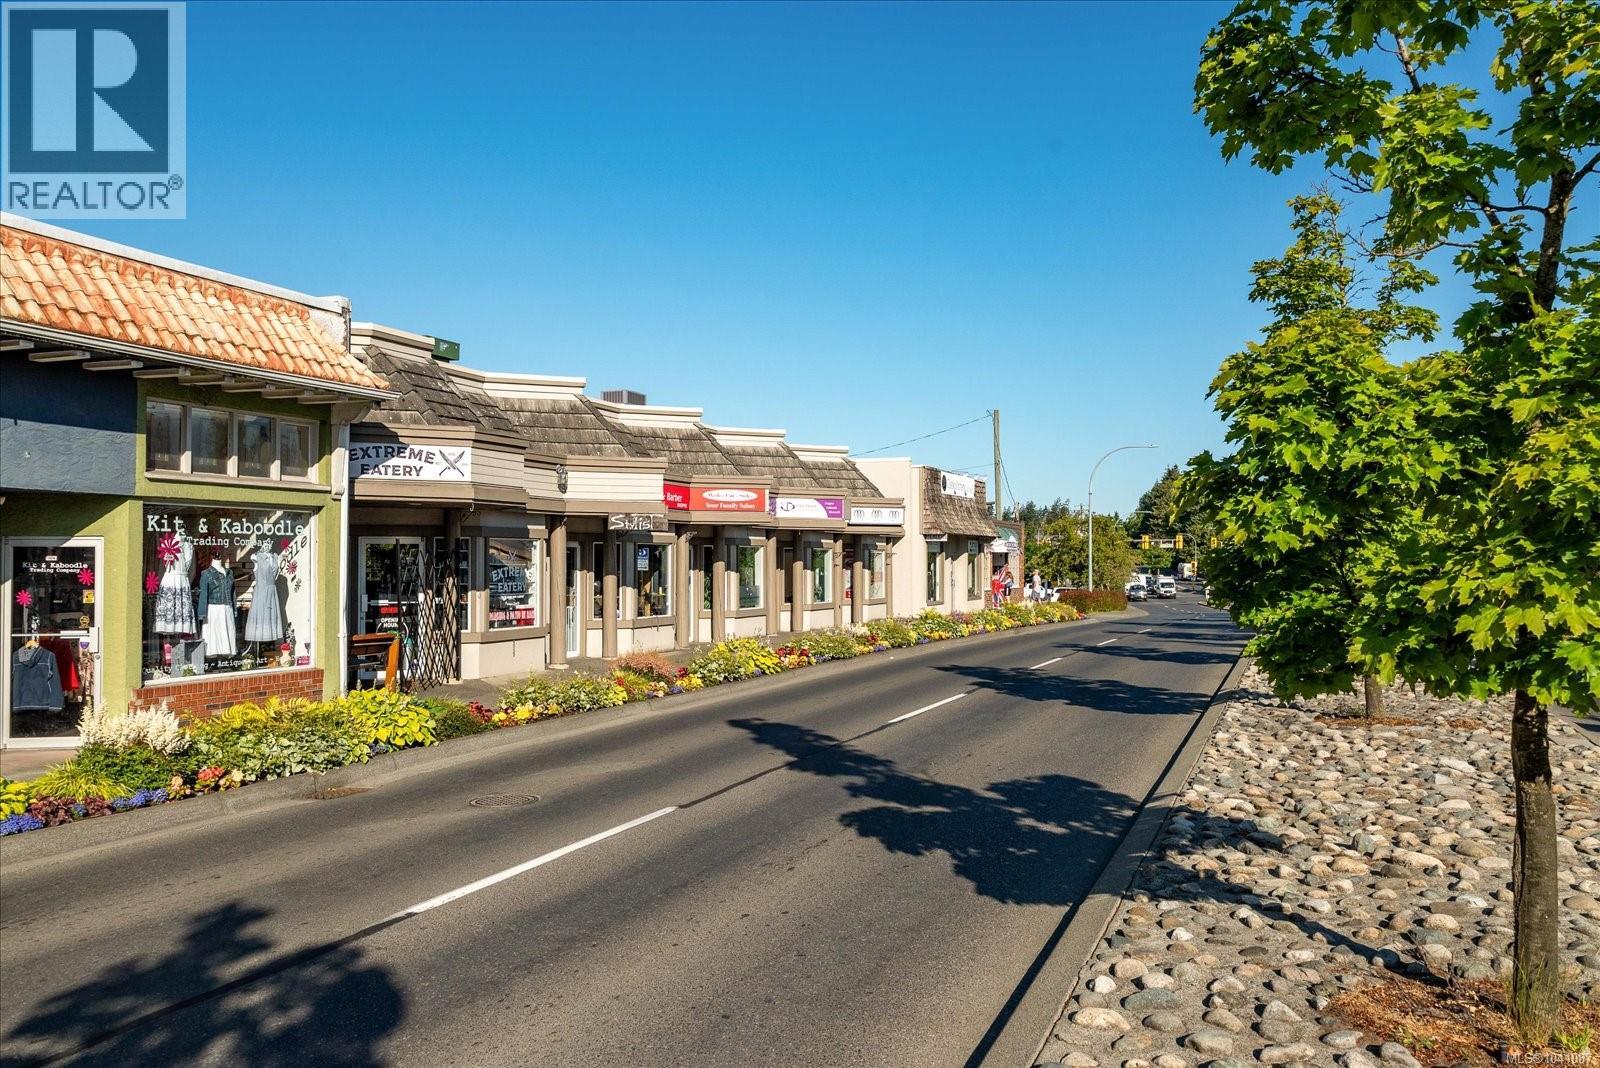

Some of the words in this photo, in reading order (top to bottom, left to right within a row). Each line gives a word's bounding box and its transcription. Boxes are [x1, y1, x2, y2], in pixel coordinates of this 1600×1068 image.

[349, 445, 436, 464] EXTREME
[360, 463, 423, 477] EATERY
[666, 491, 683, 503] Barber
[147, 514, 184, 533] Kit
[198, 518, 208, 533] &
[220, 517, 305, 536] Kaboodle
[186, 536, 229, 548] Trading
[491, 566, 526, 582] EXTRE
[497, 581, 527, 593] EATERY
